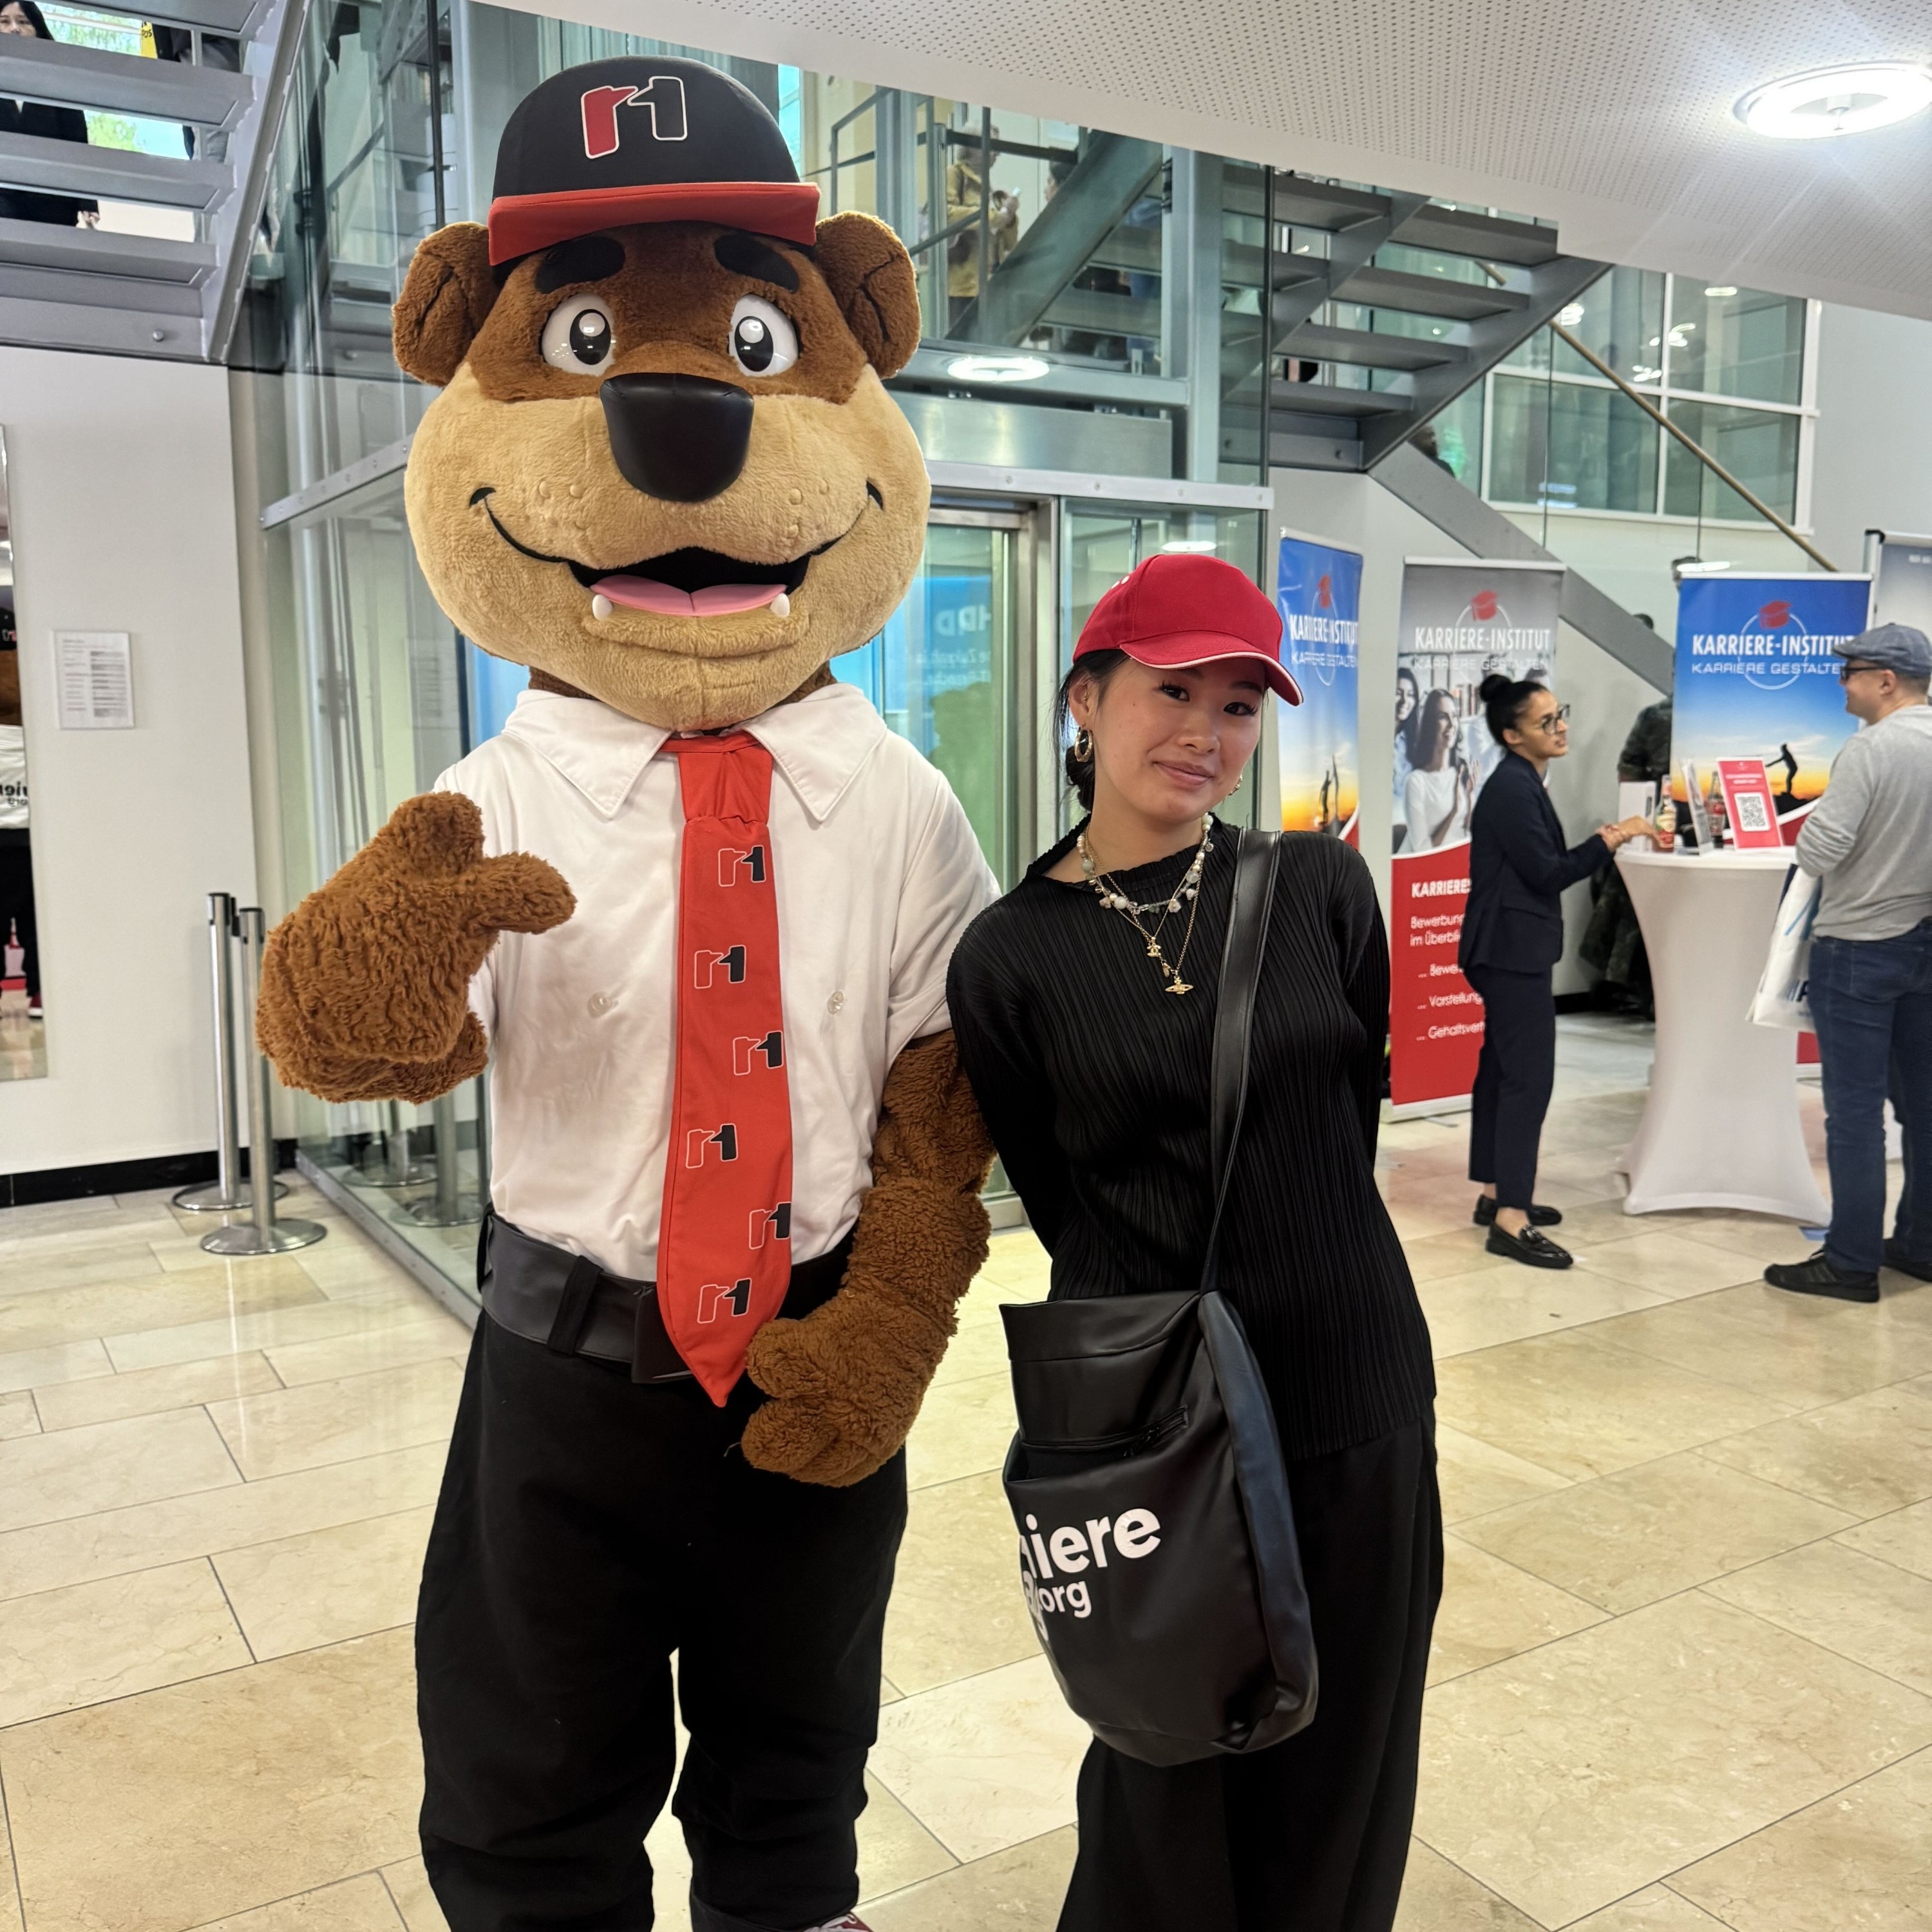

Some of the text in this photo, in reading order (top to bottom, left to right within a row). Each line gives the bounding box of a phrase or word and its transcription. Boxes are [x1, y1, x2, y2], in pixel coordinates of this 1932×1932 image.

[1415, 627, 1551, 650] KARRIERE-INSTITUT
[1414, 657, 1477, 670] KARRIERE
[1692, 662, 1846, 674] KARRIERE GESTALTE
